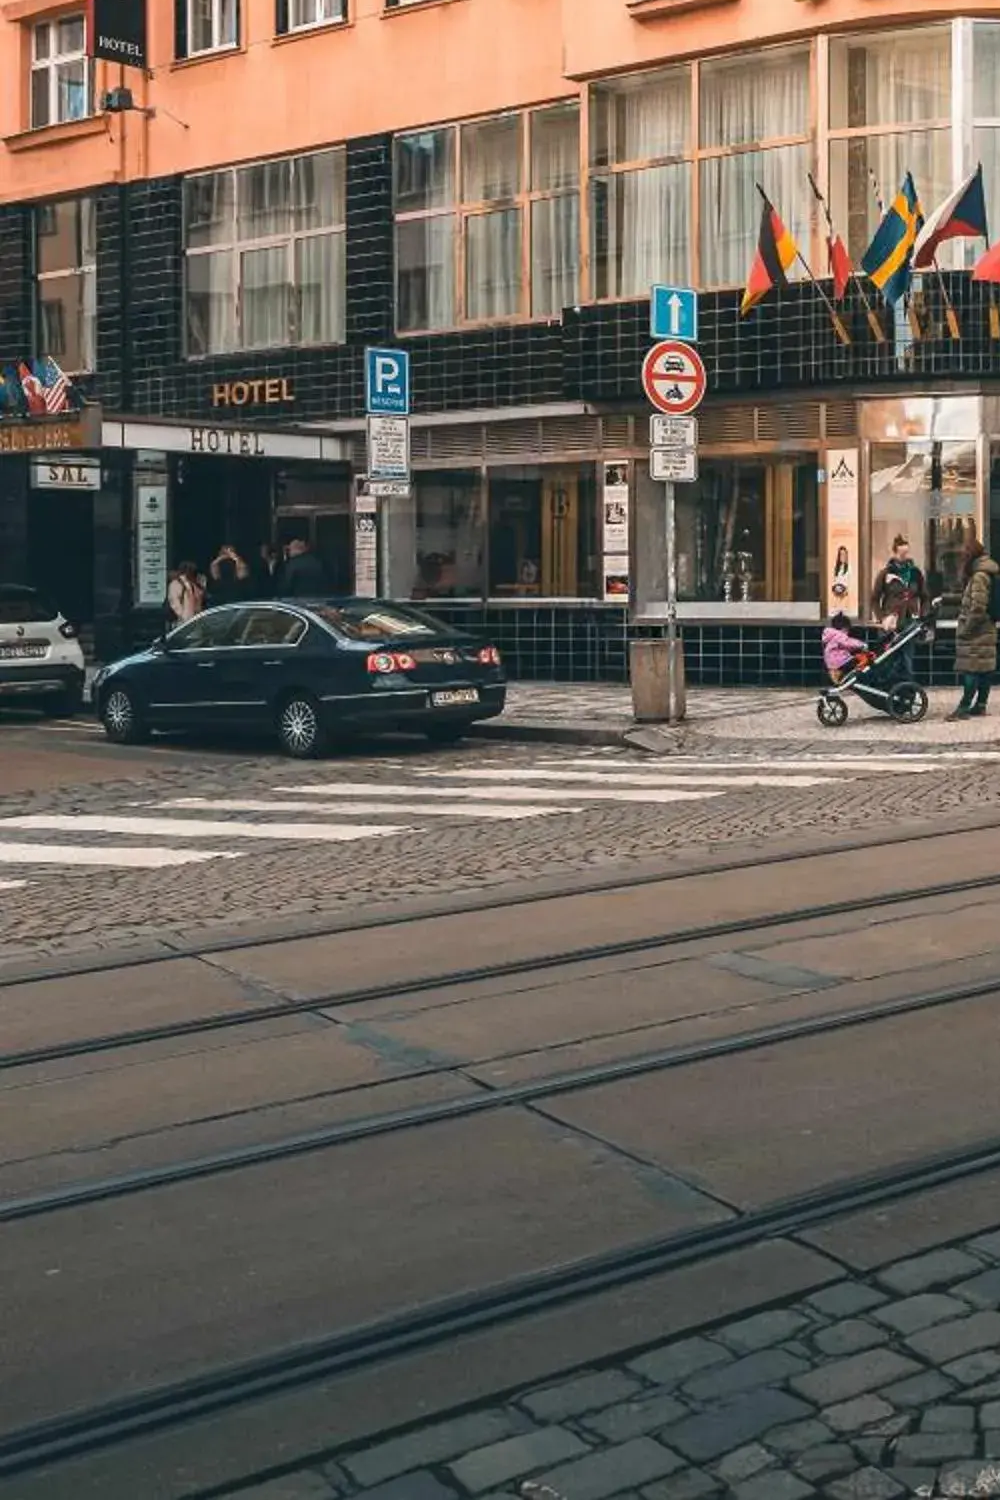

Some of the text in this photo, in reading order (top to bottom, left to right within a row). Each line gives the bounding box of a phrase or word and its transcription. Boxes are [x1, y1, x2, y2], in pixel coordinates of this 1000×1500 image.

[99, 35, 143, 57] HOTEL
[375, 356, 399, 392] P
[213, 379, 295, 407] HOTEL
[191, 428, 265, 455] HOTEL
